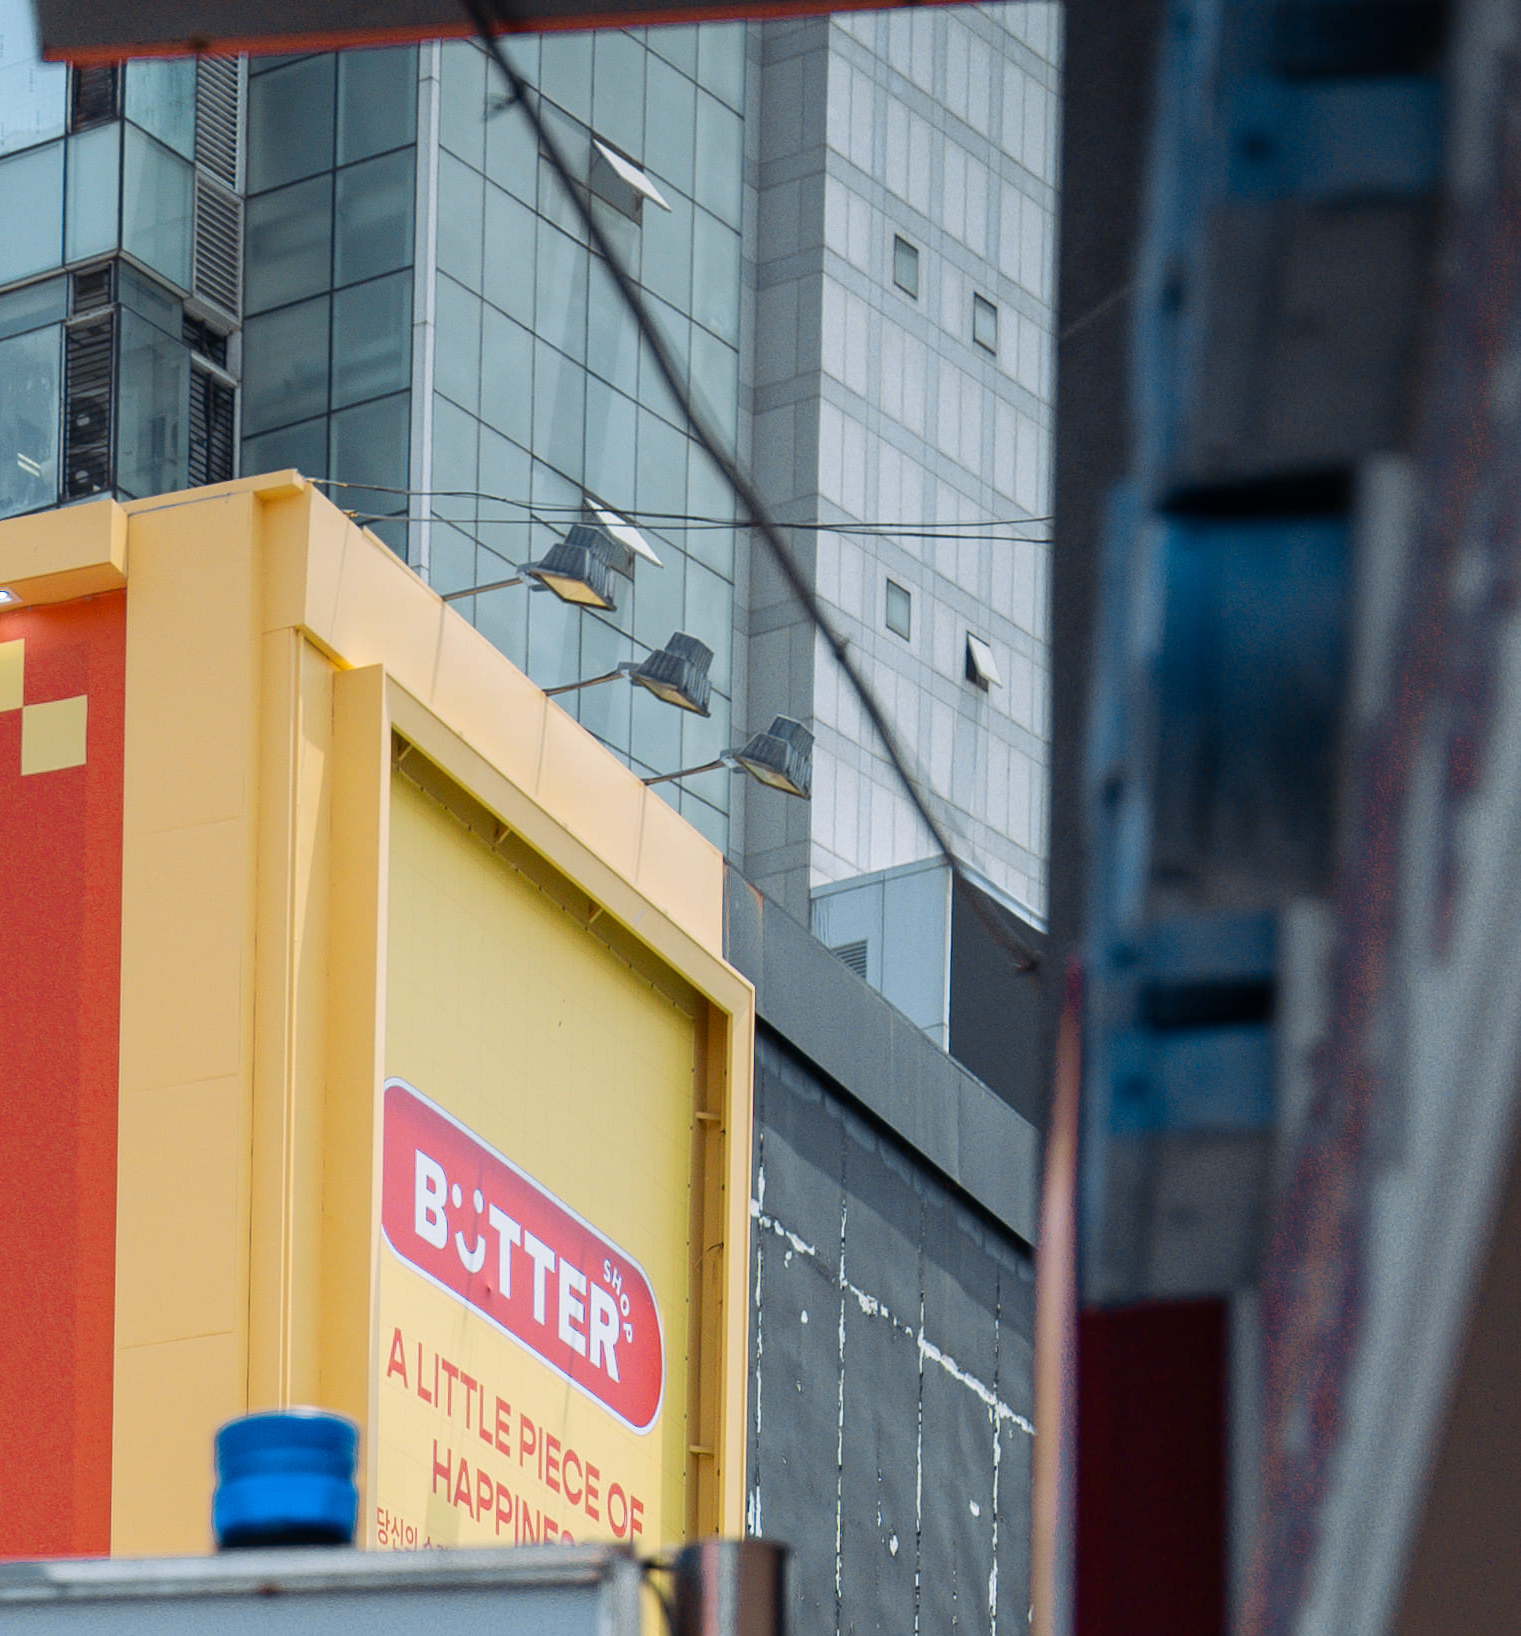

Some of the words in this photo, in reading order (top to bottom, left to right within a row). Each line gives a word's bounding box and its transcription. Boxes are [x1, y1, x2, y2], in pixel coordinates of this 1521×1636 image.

[414, 1148, 620, 1384] BUTTER
[603, 1257, 633, 1344] SHOP
[386, 1328, 409, 1390] A
[417, 1341, 511, 1458] LITTLE
[519, 1413, 600, 1520] PIECE
[607, 1483, 645, 1543] OF
